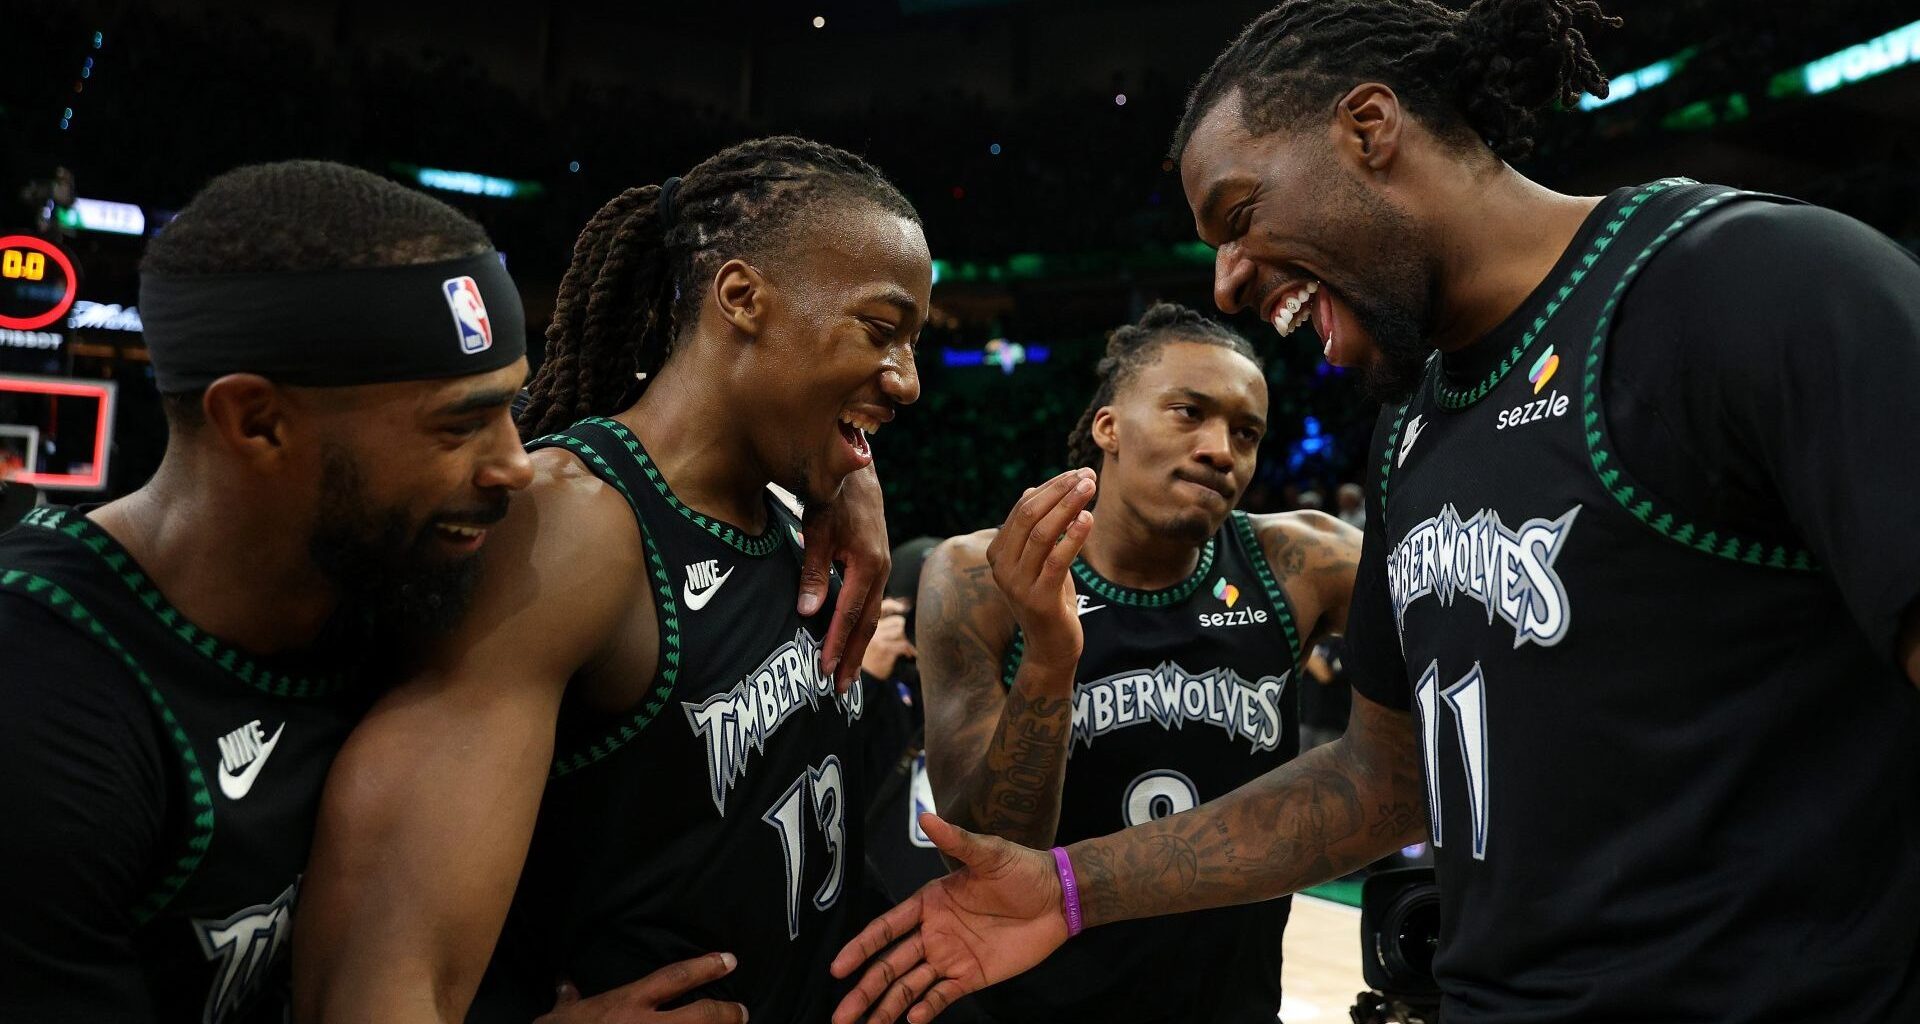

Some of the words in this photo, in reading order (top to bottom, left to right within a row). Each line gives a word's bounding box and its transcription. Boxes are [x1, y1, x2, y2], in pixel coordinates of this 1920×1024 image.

[1496, 389, 1569, 430] sezzle
[685, 559, 720, 591] NIKE
[1199, 606, 1268, 627] sezzle
[218, 719, 265, 773] NIKE
[1417, 658, 1488, 861] 11
[763, 754, 847, 941] 13
